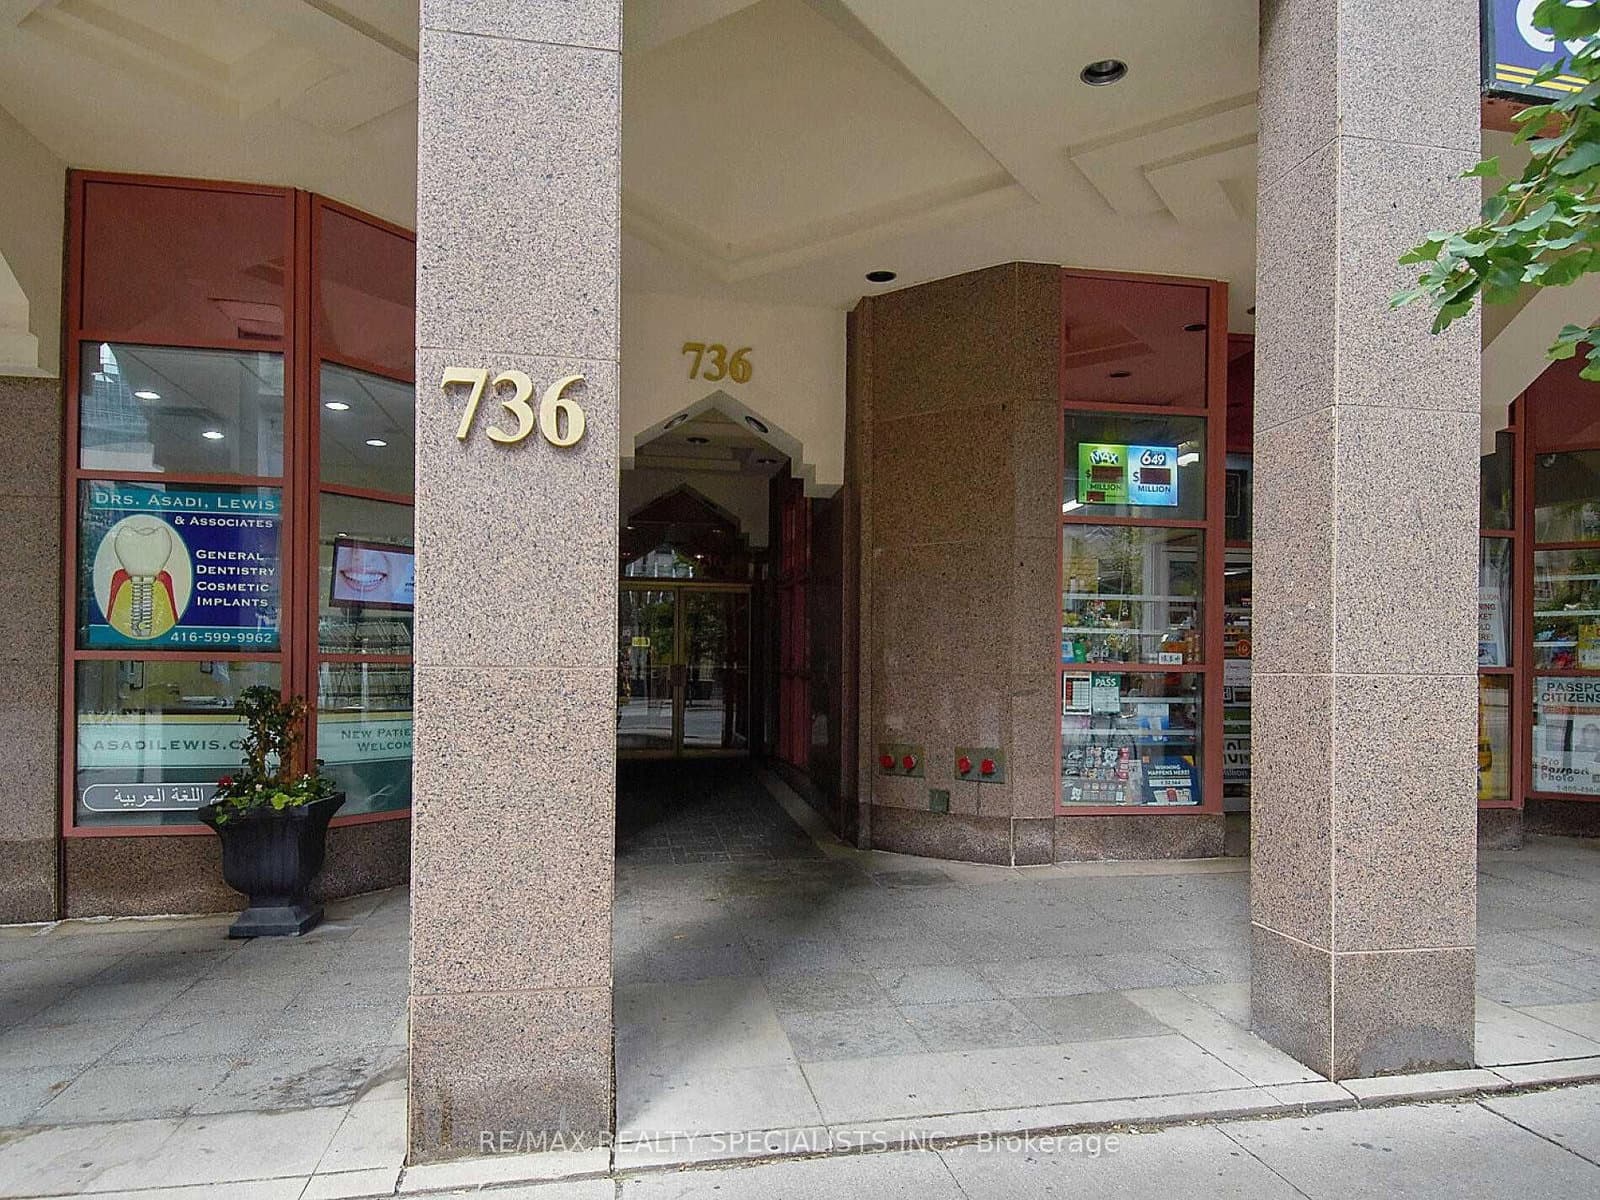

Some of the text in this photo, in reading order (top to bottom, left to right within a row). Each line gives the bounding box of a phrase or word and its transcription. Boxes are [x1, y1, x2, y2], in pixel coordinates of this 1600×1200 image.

[682, 342, 753, 384] 736
[441, 366, 586, 447] 736
[1090, 450, 1118, 464] MAX
[1141, 449, 1166, 465] 649
[1138, 485, 1171, 493] MILLION
[95, 492, 139, 505] DRS.
[217, 497, 275, 510] LEWIS
[174, 516, 273, 528] & ASSOCIATES
[196, 550, 264, 561] GENERAL
[196, 565, 275, 576] DENTISTRY
[197, 582, 270, 592] COSMETIC
[197, 596, 268, 607] IMPLANTS
[171, 632, 272, 643] 416-599-9962
[1095, 678, 1116, 687] PASS
[341, 729, 372, 740] NEW
[114, 787, 165, 807] العربية
[171, 787, 204, 802] اللغة
